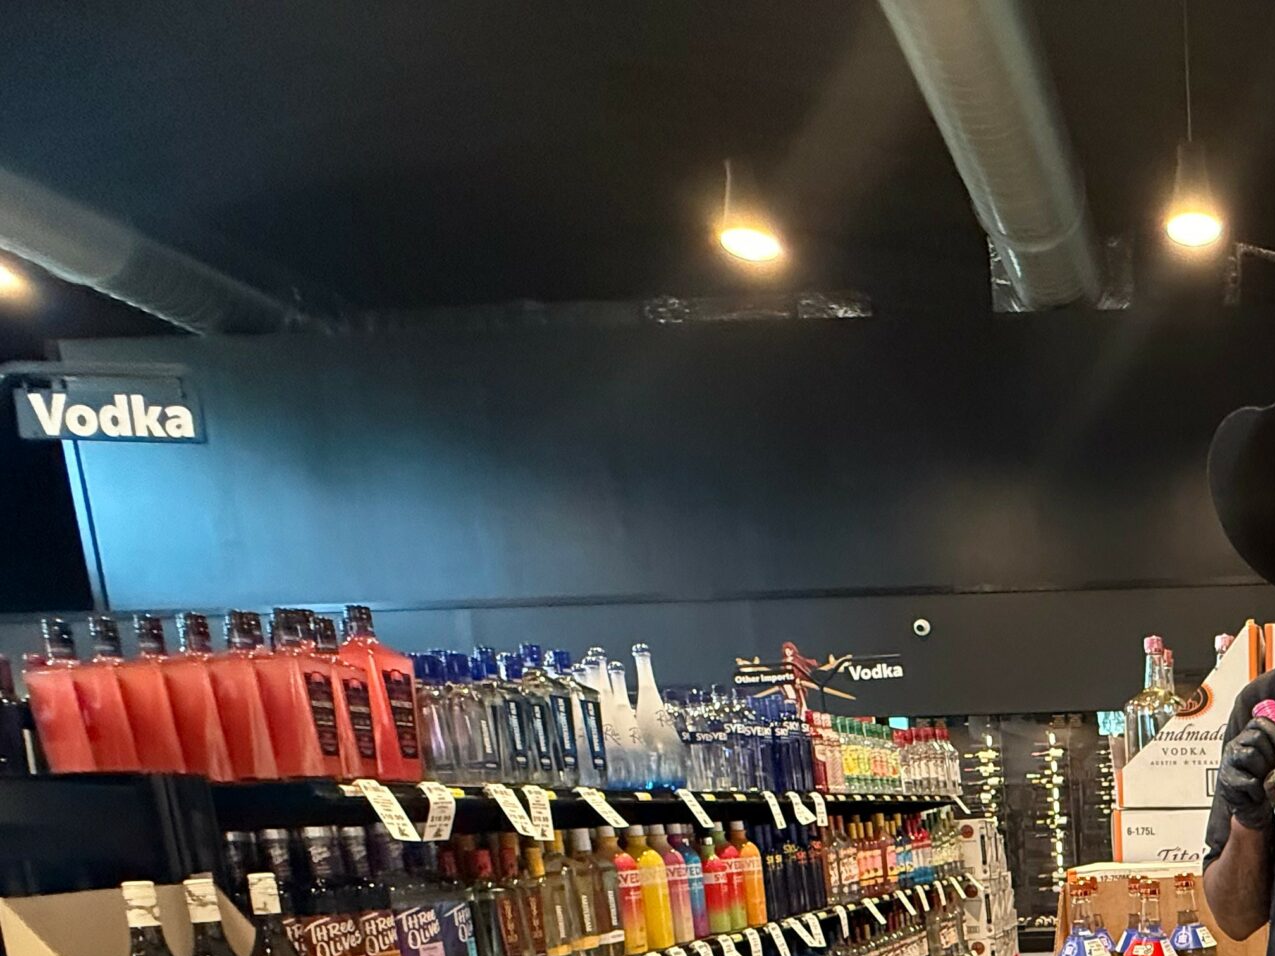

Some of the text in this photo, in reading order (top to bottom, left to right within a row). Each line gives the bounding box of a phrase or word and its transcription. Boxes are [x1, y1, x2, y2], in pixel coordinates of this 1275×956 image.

[27, 392, 196, 438] Vodka
[734, 672, 795, 684] Other Imports
[849, 663, 904, 681] Vodka
[1161, 747, 1207, 756] VODKA
